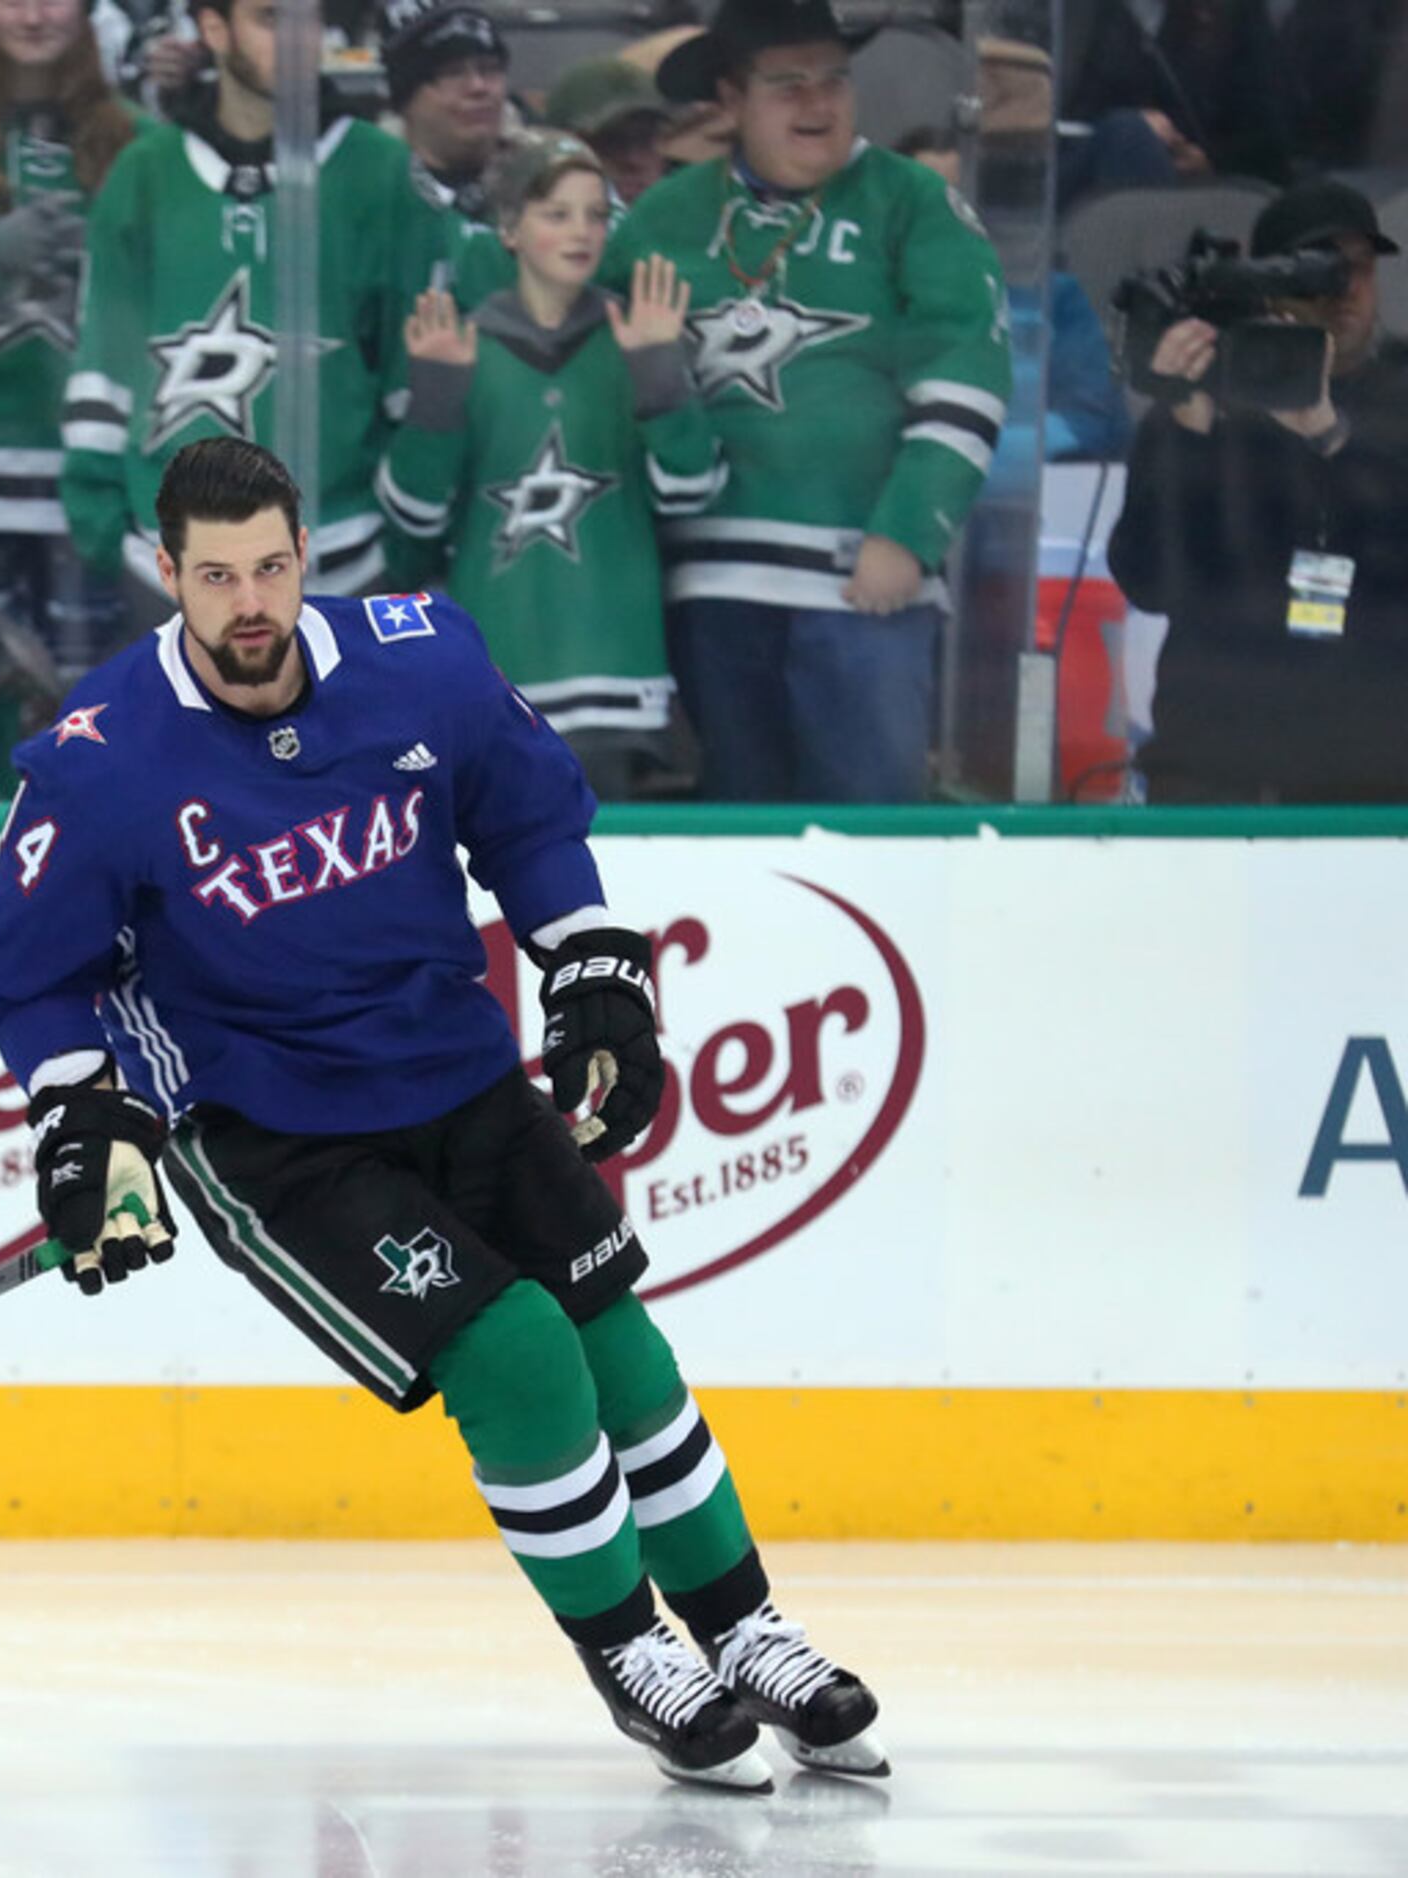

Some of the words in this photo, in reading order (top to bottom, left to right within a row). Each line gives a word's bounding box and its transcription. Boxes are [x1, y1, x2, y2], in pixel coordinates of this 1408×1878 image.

[827, 219, 861, 263] C
[177, 797, 221, 870] C
[192, 786, 426, 920] TEXAS
